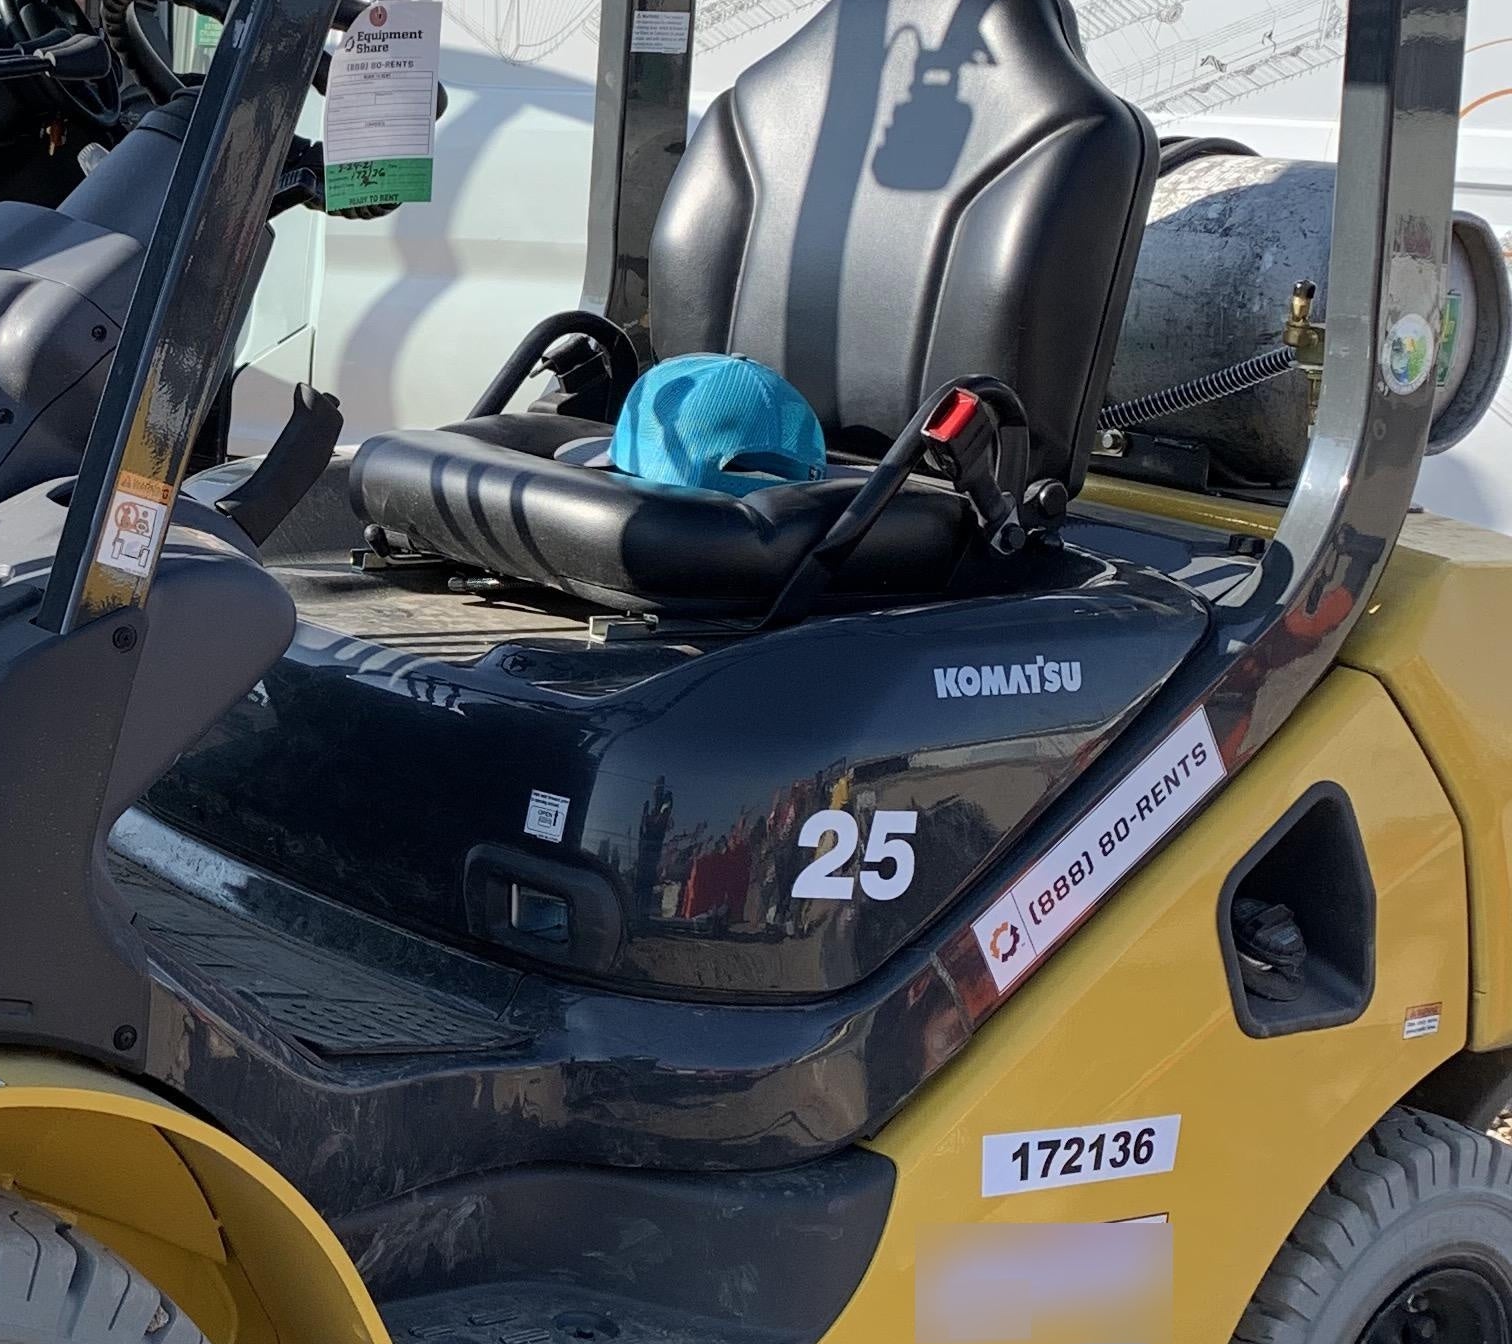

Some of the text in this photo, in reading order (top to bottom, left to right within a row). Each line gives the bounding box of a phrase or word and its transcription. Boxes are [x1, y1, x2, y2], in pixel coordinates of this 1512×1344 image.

[356, 44, 389, 54] Share
[357, 30, 424, 44] Equipment
[934, 655, 1082, 698] KOMATSU
[791, 809, 918, 901] 25
[1029, 742, 1207, 925] (888) 80-RENTS
[1012, 1127, 1156, 1182] 172136
